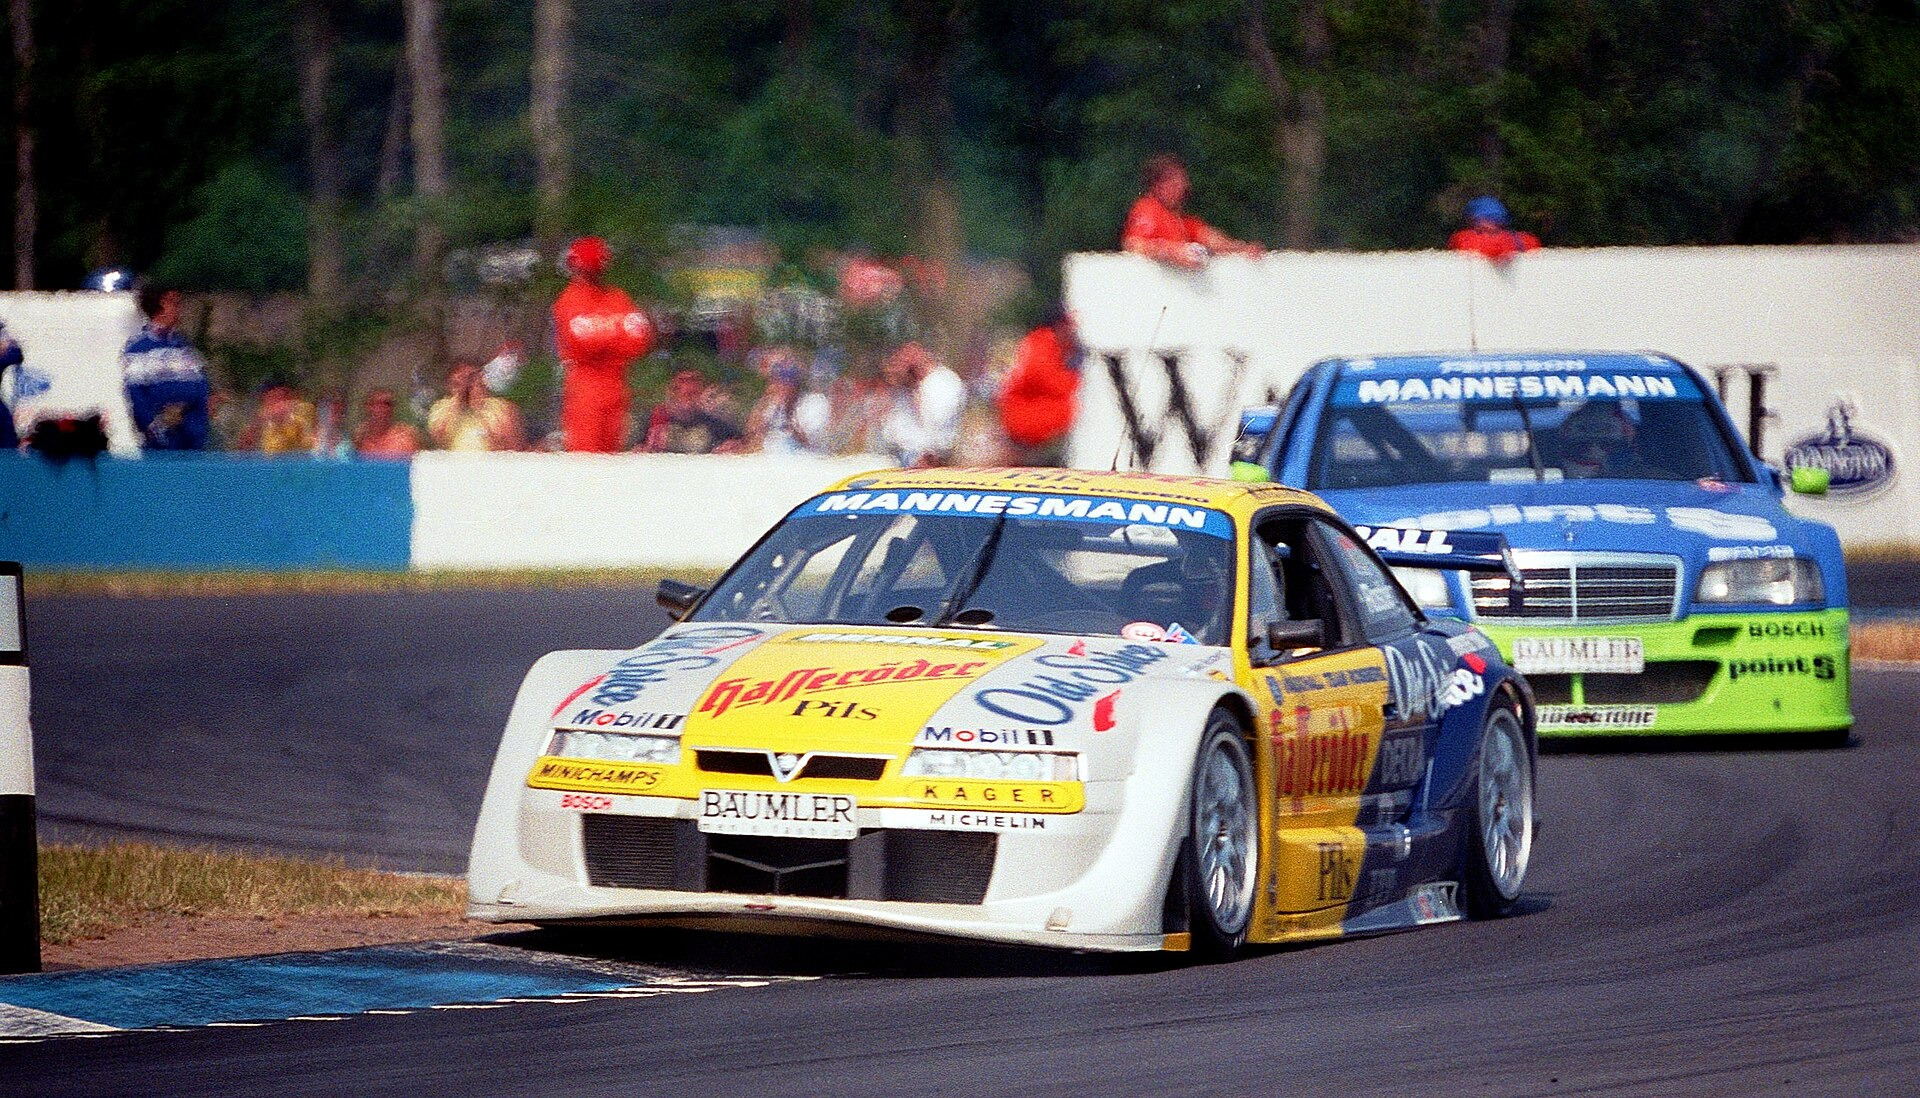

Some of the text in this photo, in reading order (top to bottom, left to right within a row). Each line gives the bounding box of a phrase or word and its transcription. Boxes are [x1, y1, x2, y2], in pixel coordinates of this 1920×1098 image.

[1357, 375, 1678, 403] MANNESMANN
[1013, 482, 1080, 492] TEAM
[817, 492, 1208, 529] MANNESMANN
[1750, 622, 1825, 637] BOSCH
[1729, 657, 1811, 682] point
[573, 709, 654, 728] Mobil
[791, 700, 880, 721] Pils
[925, 727, 1018, 745] Mobil
[540, 762, 659, 786] MINICHAMPS
[561, 795, 612, 810] BOSCH
[924, 785, 1054, 803] KAGER
[930, 814, 1045, 829] MICHELIN
